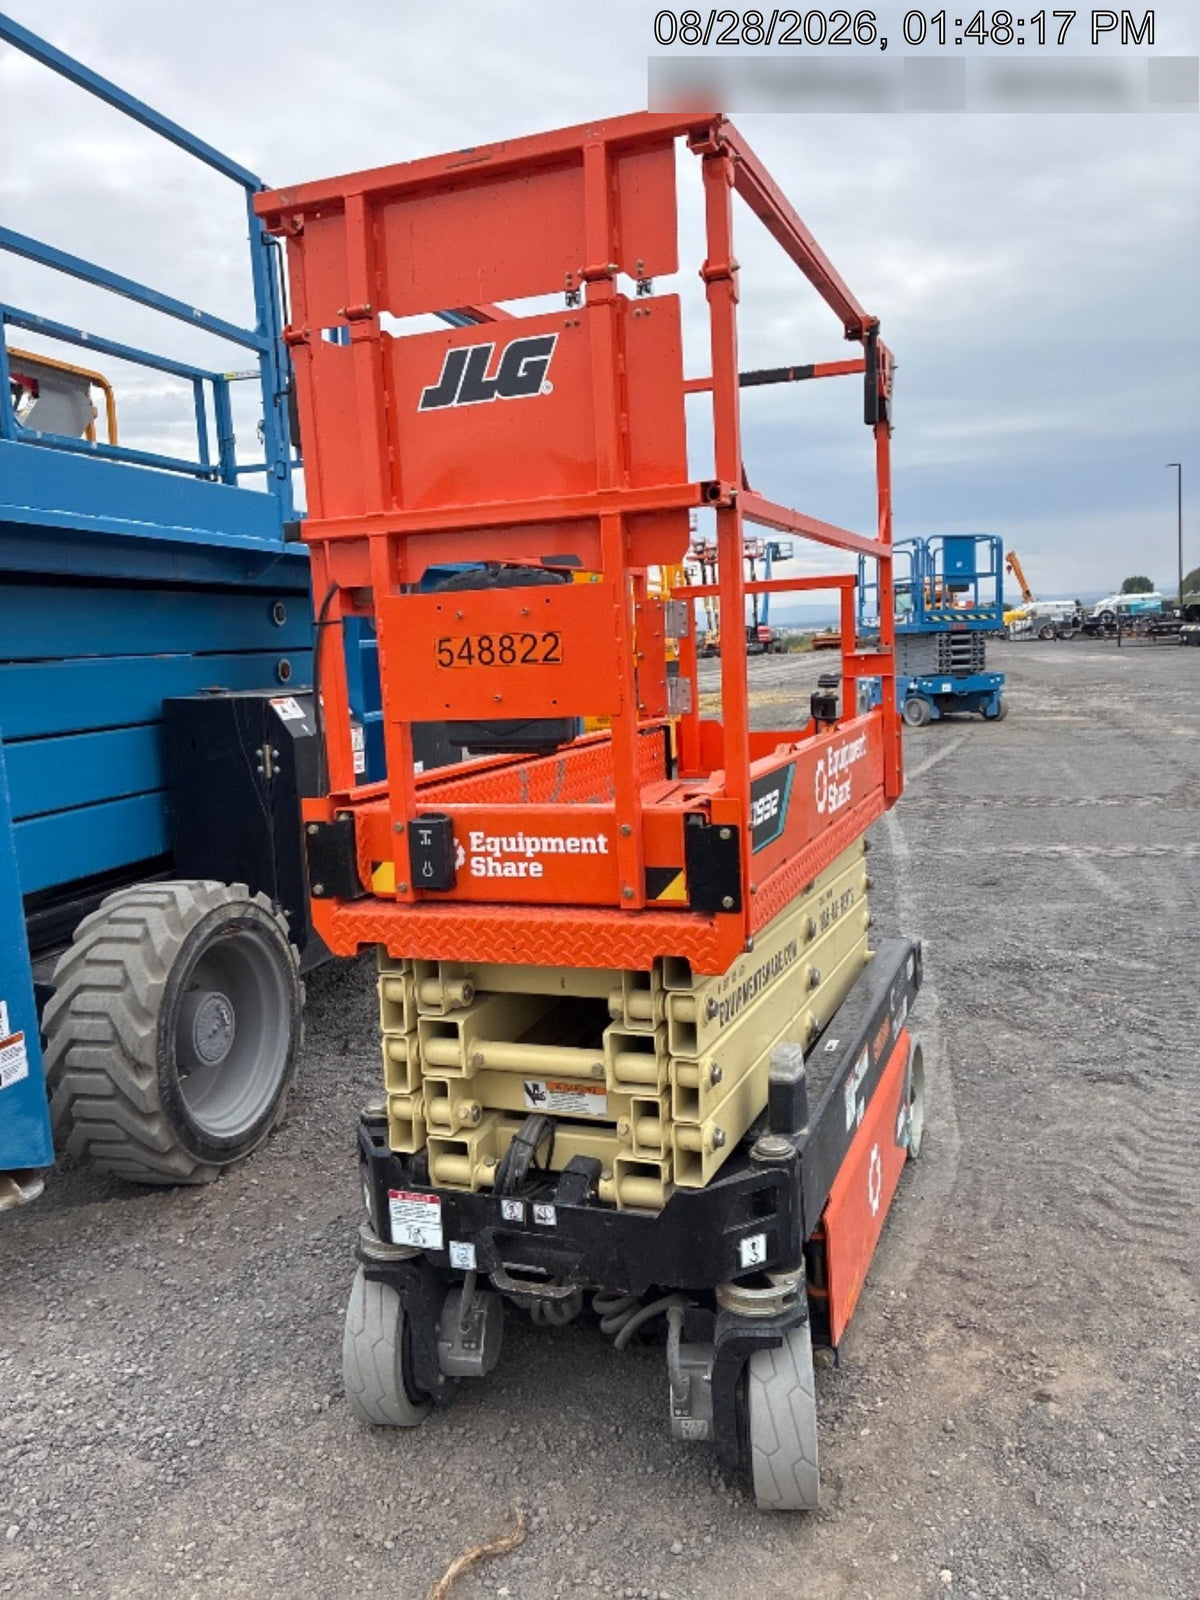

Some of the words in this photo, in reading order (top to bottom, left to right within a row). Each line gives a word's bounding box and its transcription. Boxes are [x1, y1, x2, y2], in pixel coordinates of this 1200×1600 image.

[417, 332, 560, 412] JLG
[437, 631, 561, 668] 548822
[827, 731, 867, 779] Equipment
[828, 777, 852, 815] Share
[469, 831, 609, 857] Equipment
[470, 856, 544, 878] Share
